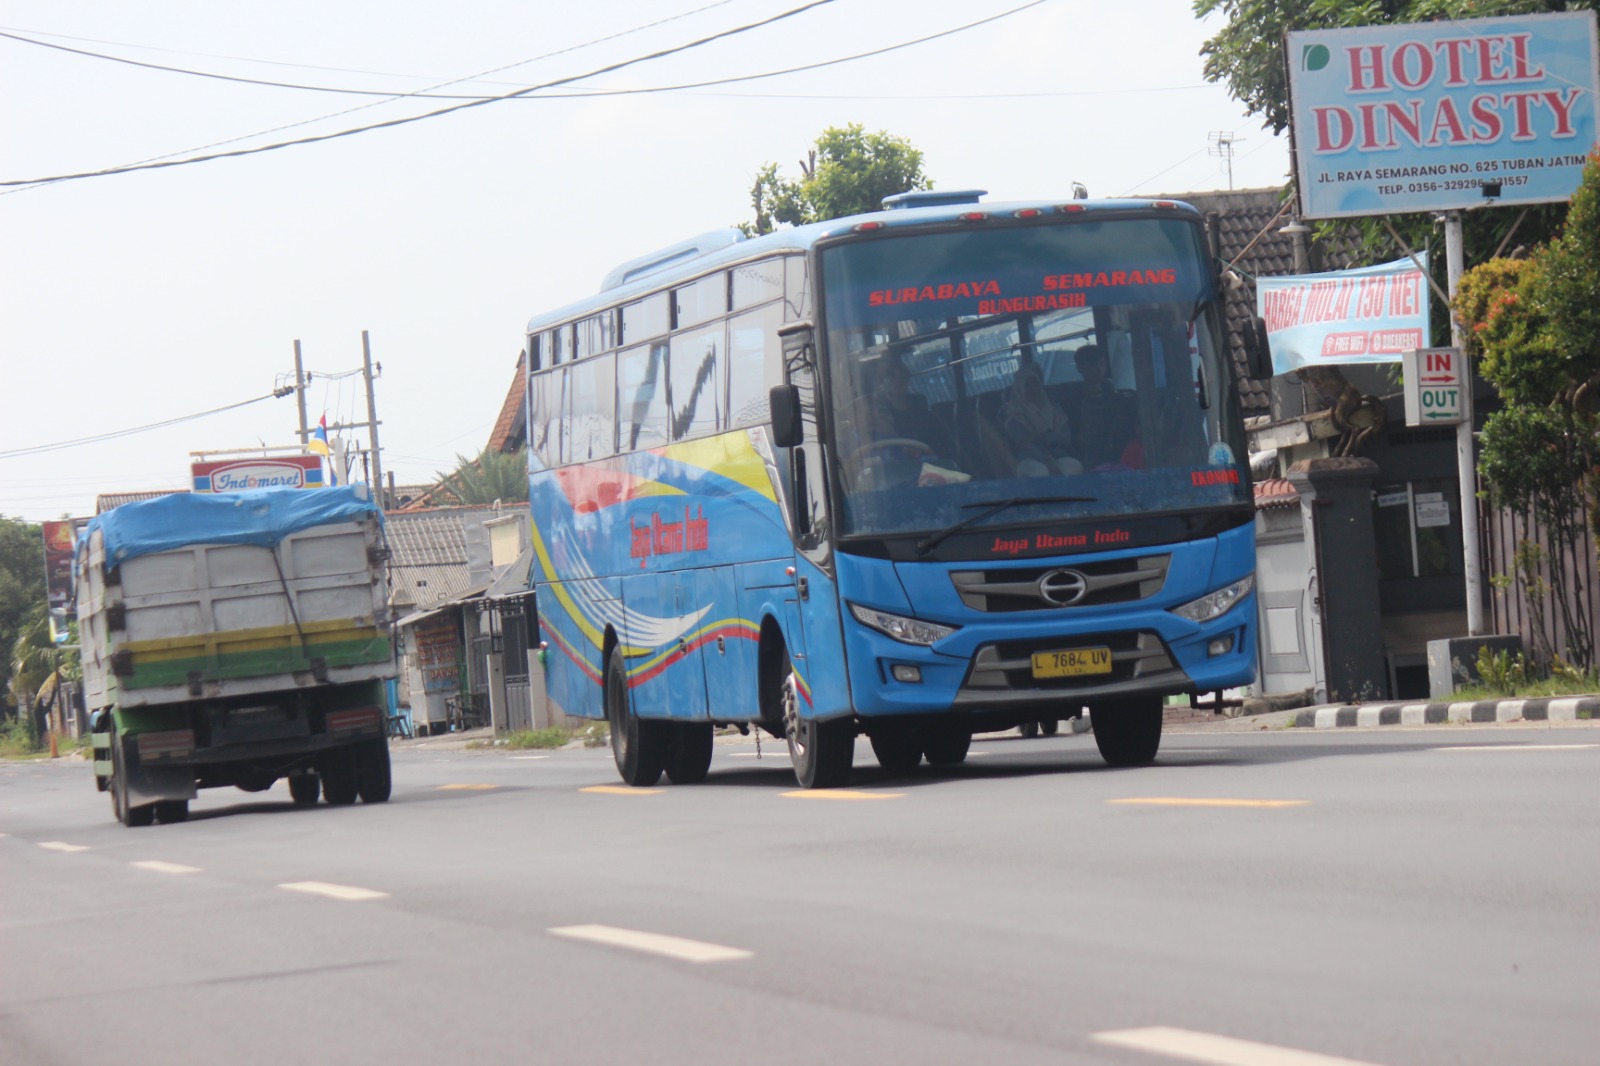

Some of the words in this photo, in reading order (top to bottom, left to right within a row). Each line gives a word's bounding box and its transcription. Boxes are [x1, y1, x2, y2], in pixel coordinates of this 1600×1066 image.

[1346, 33, 1544, 91] HOTEL
[1312, 90, 1581, 151] DINASTY
[1318, 172, 1334, 183] JL.
[1338, 170, 1372, 182] RAYA
[1375, 165, 1447, 179] SEMARANG
[1450, 163, 1472, 174] NO.
[1476, 161, 1498, 172] 625
[1501, 158, 1544, 170] TUBAN
[1547, 155, 1586, 168] JATIM
[1378, 184, 1406, 195] TELP.
[869, 280, 1001, 307] SURABAYA
[1043, 269, 1176, 290] SEMARANG
[978, 293, 1086, 315] BUNGURASIH
[1264, 285, 1306, 333] HARGA
[1302, 278, 1354, 324] MULAI
[1355, 276, 1387, 319] 150
[1388, 270, 1422, 316] NET
[1335, 336, 1350, 352] FREE
[1382, 332, 1418, 350] BREAKFAST
[1426, 354, 1451, 371] IN
[1422, 390, 1458, 408] OUT
[216, 472, 299, 489] Indomaret
[1191, 469, 1239, 487] EKONOMI
[630, 516, 651, 569] Jaya
[652, 511, 683, 556] Utama
[685, 504, 709, 552] Indo
[992, 538, 1028, 554] Jaya
[1036, 534, 1087, 548] Utama
[1094, 528, 1130, 544] Indo
[1035, 655, 1043, 669] L
[1092, 651, 1107, 664] UV
